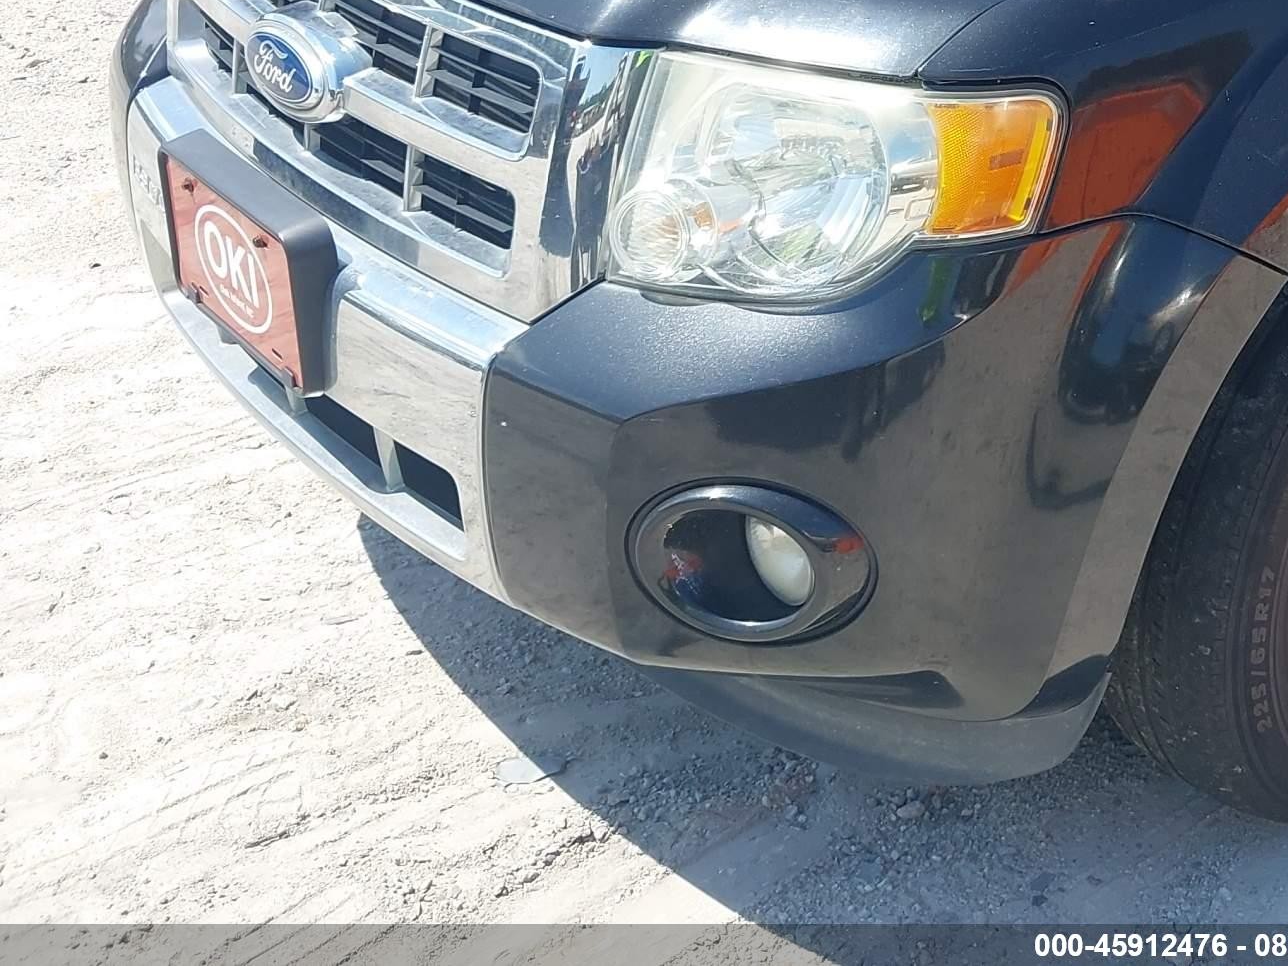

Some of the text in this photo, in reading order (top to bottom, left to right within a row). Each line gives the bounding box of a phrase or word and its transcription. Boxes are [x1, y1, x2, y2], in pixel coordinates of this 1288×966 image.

[254, 40, 296, 93] Ford
[204, 221, 259, 308] OKI
[1250, 566, 1275, 732] 225/65R17
